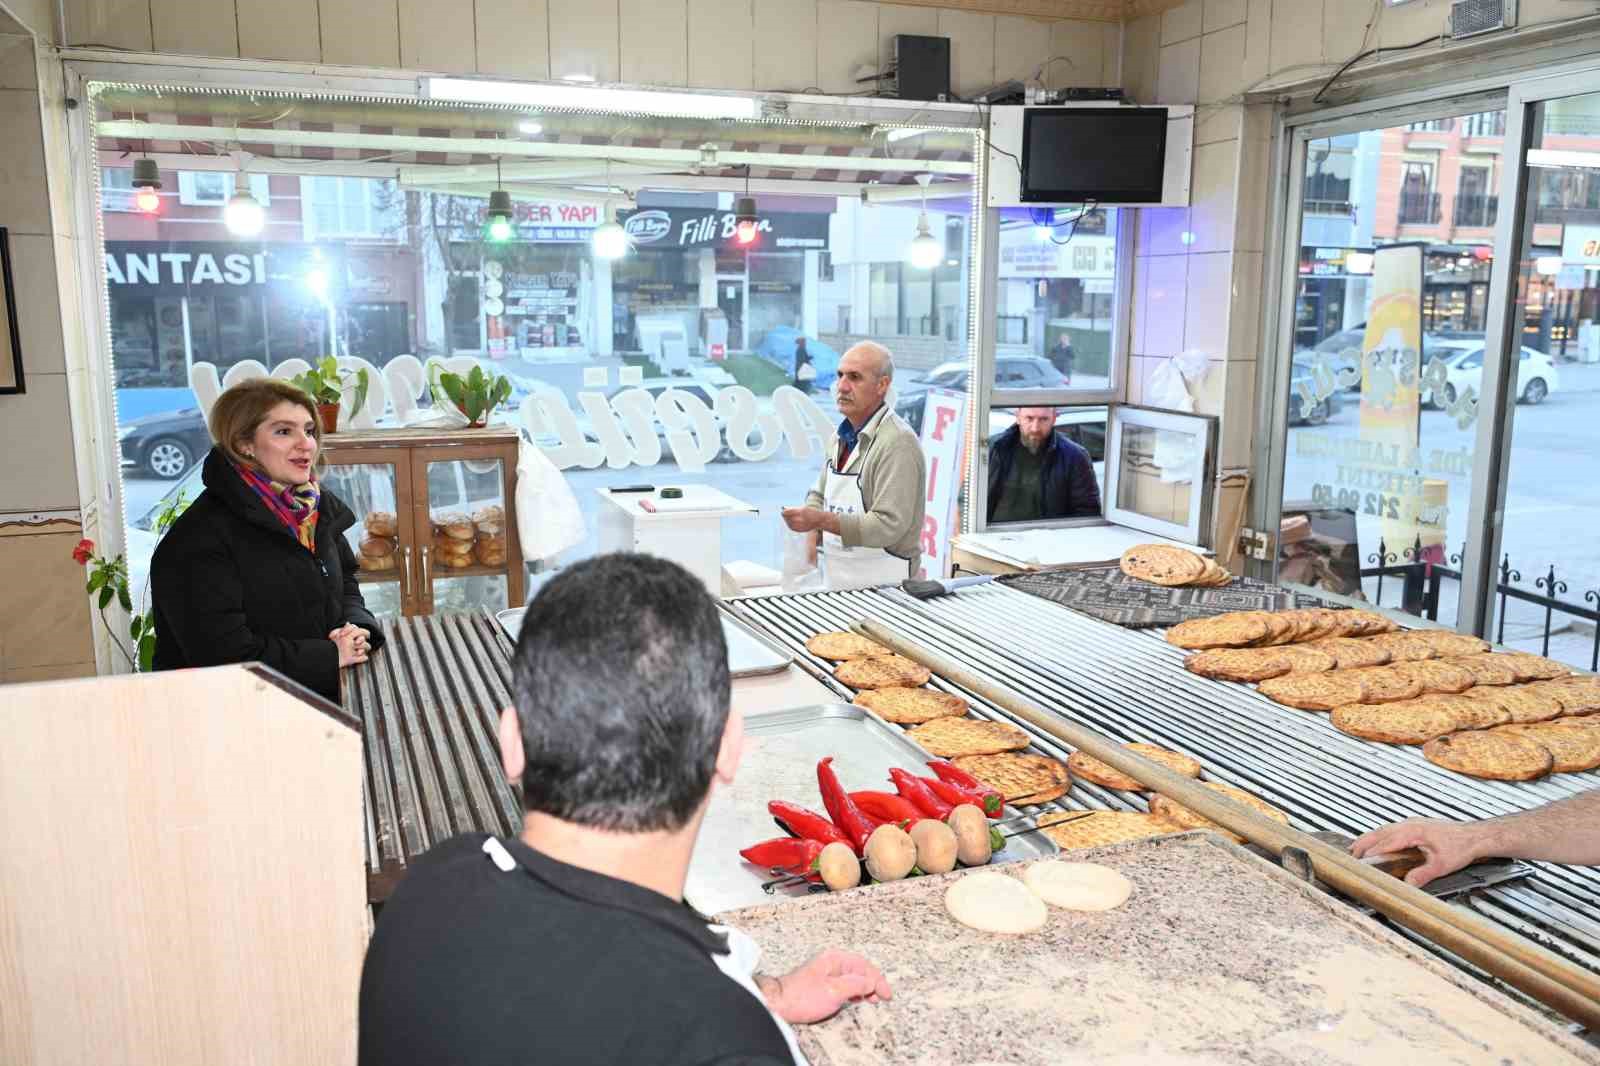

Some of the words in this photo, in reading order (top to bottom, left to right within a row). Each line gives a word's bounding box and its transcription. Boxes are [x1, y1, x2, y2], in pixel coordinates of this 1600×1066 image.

[558, 205, 597, 222] YAPI
[679, 214, 720, 246] Filli
[914, 402, 957, 581] FIR
